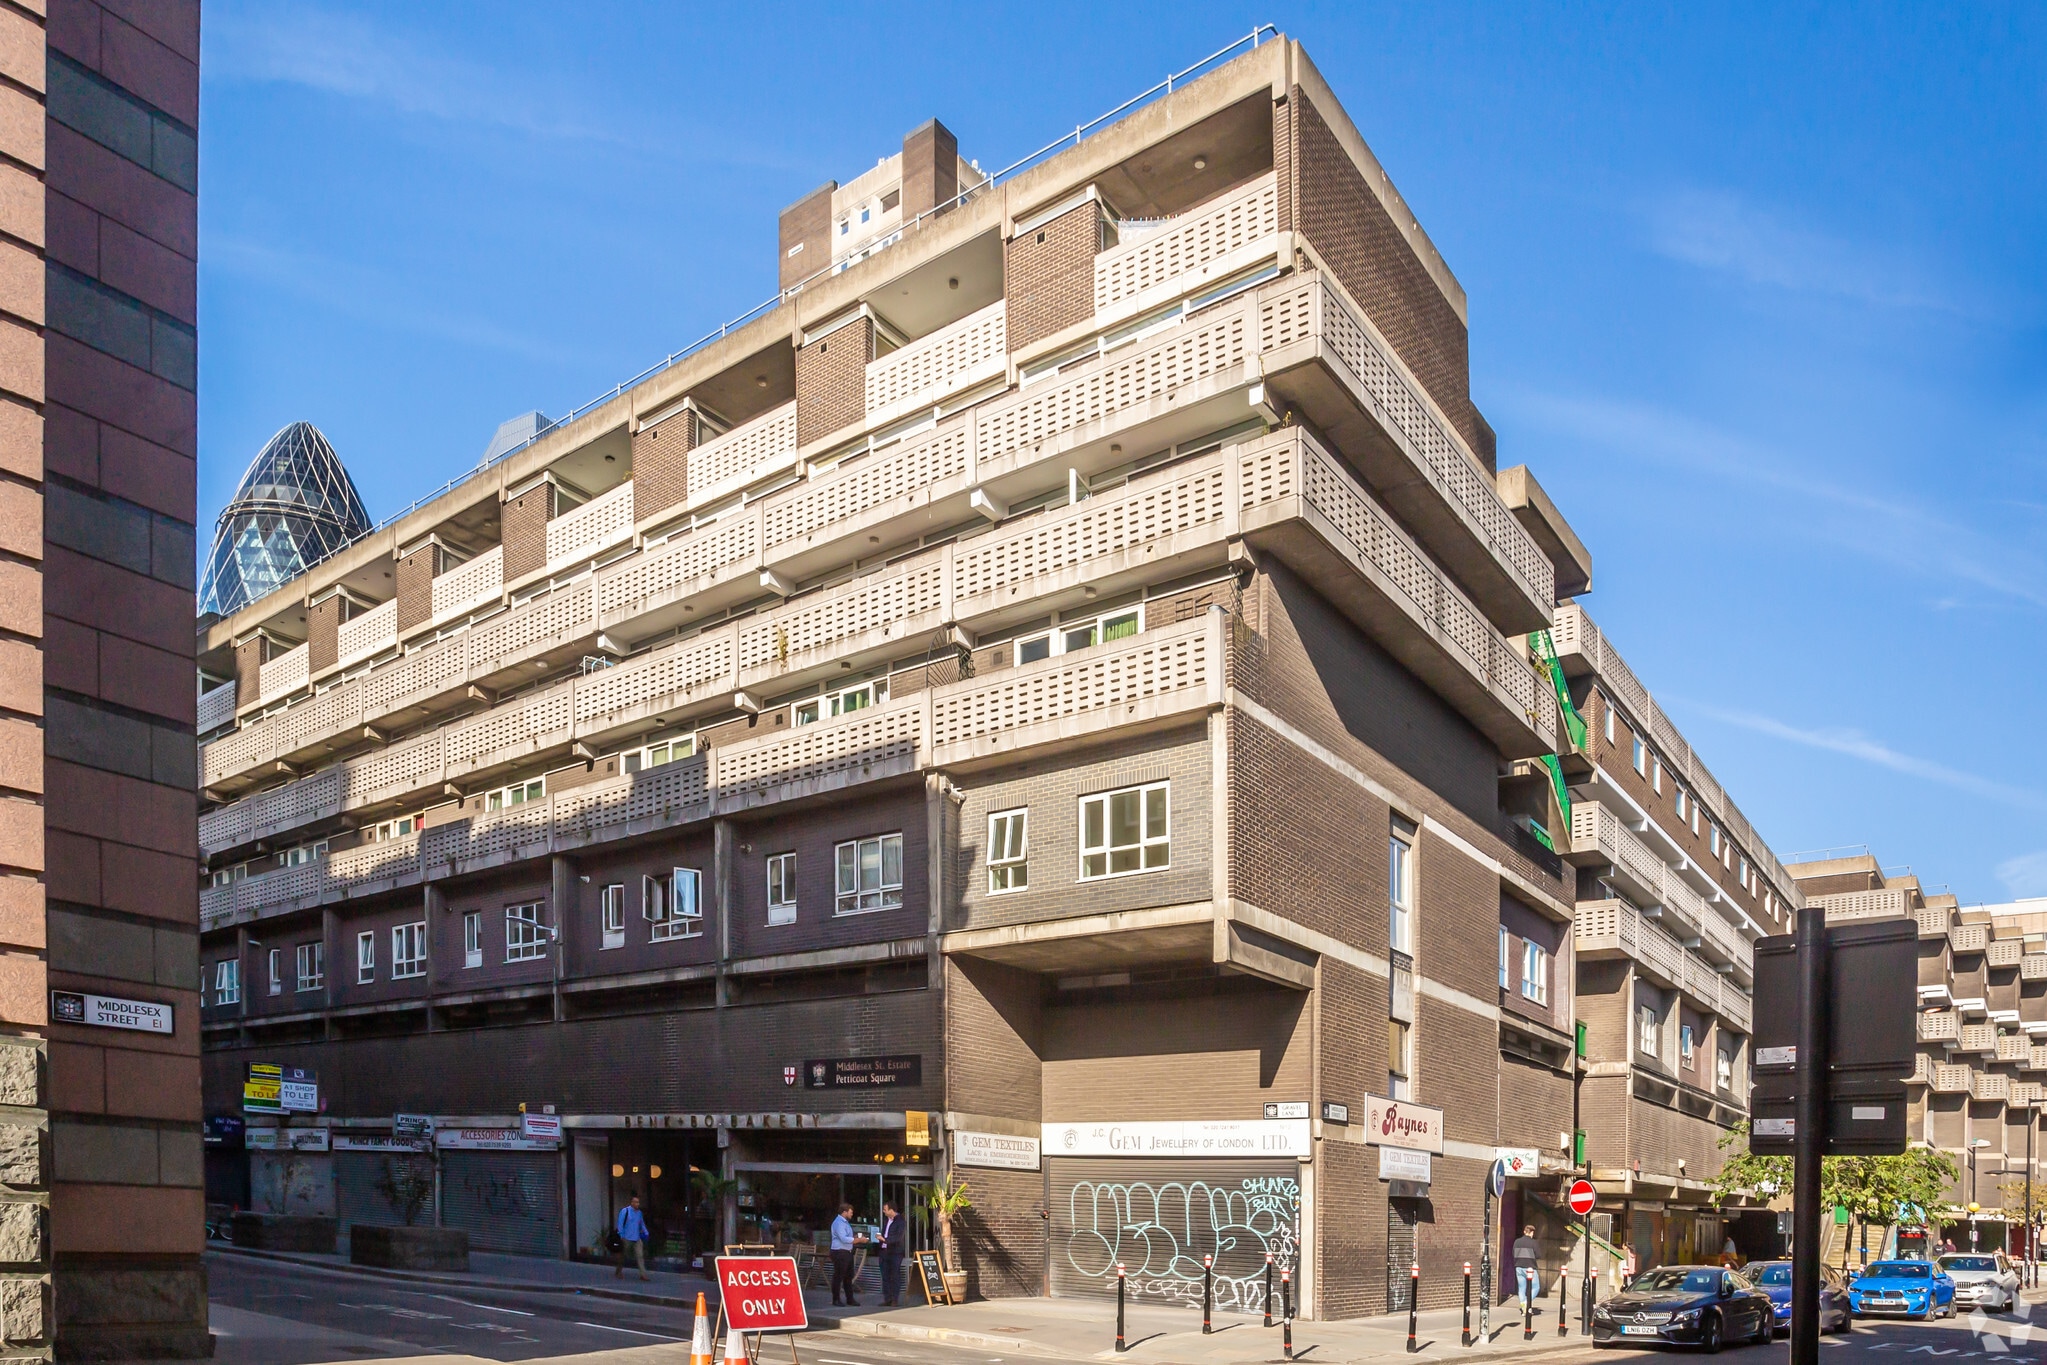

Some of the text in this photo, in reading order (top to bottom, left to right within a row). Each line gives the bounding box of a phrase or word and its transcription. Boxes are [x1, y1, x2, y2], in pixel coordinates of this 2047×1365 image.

[97, 1000, 161, 1017] MIDDLESEX
[97, 1012, 162, 1028] STREET E1
[836, 1059, 911, 1072] Middlesex St. Estate
[835, 1071, 896, 1084] Petticoat Square
[251, 1090, 264, 1099] TO
[284, 1091, 315, 1100] TO LET
[730, 1114, 820, 1128] BAKERY
[1382, 1104, 1428, 1136] Raynes
[348, 1137, 370, 1146] PRINCE
[371, 1137, 389, 1146] FANCY
[460, 1129, 506, 1141] ACCESSORIES
[506, 1131, 524, 1141] ZON
[1092, 1127, 1292, 1150] J.C. GEM JEWELLERY OF LONDON LTD.
[972, 1136, 1035, 1152] GEM TEXTILES
[1390, 1152, 1402, 1165] GEM
[727, 1270, 791, 1287] ACCESS
[742, 1299, 786, 1317] ONLY
